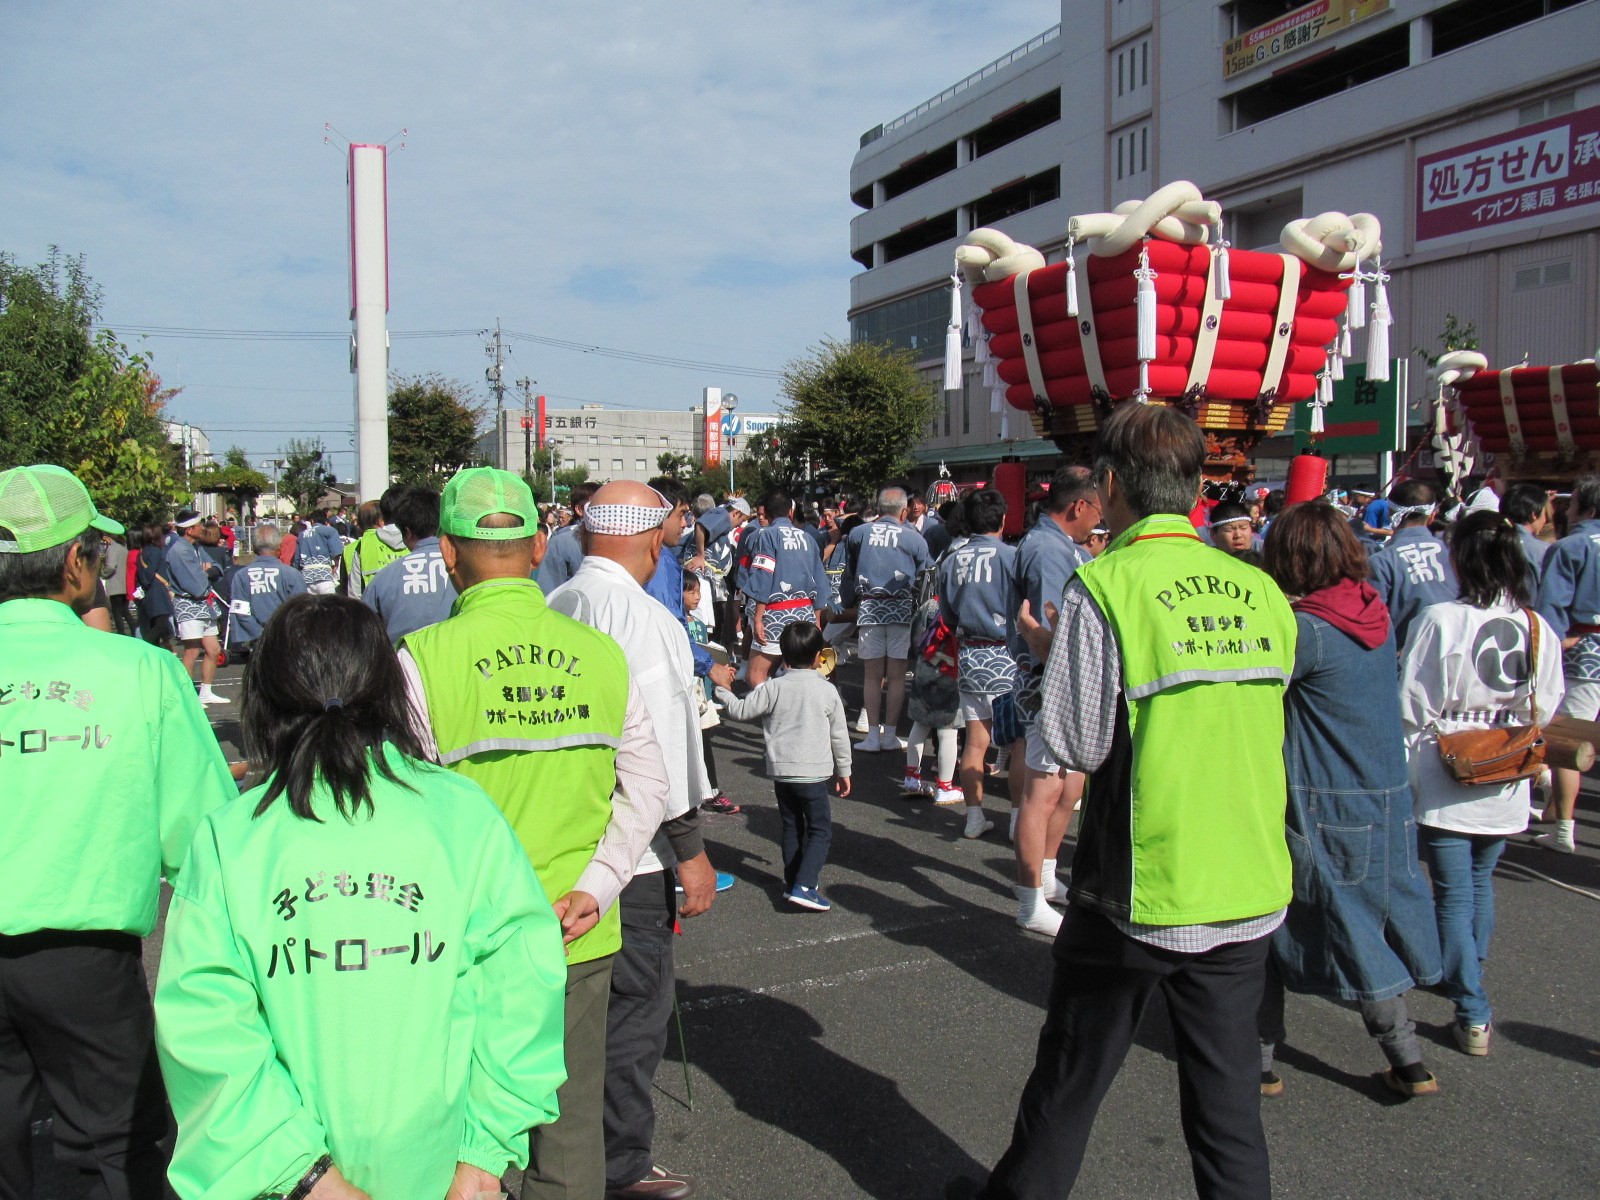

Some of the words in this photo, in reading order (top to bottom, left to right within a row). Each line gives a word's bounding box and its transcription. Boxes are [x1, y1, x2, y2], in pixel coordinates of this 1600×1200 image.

[1225, 38, 1243, 55] 毎月
[1429, 140, 1564, 204] 処方せん
[1472, 187, 1556, 222] イオン薬局
[709, 422, 719, 461] 南都銀行
[869, 524, 902, 548] 新
[247, 567, 279, 595] 新
[956, 547, 996, 585] 新
[1397, 542, 1445, 585] 新
[1156, 575, 1257, 612] PATROL
[474, 644, 581, 680] PATROL
[502, 685, 565, 702] 名張少年
[486, 704, 590, 725] サポートふれあい隊
[273, 870, 424, 921] 子ども安全
[267, 930, 445, 979] パトロール
